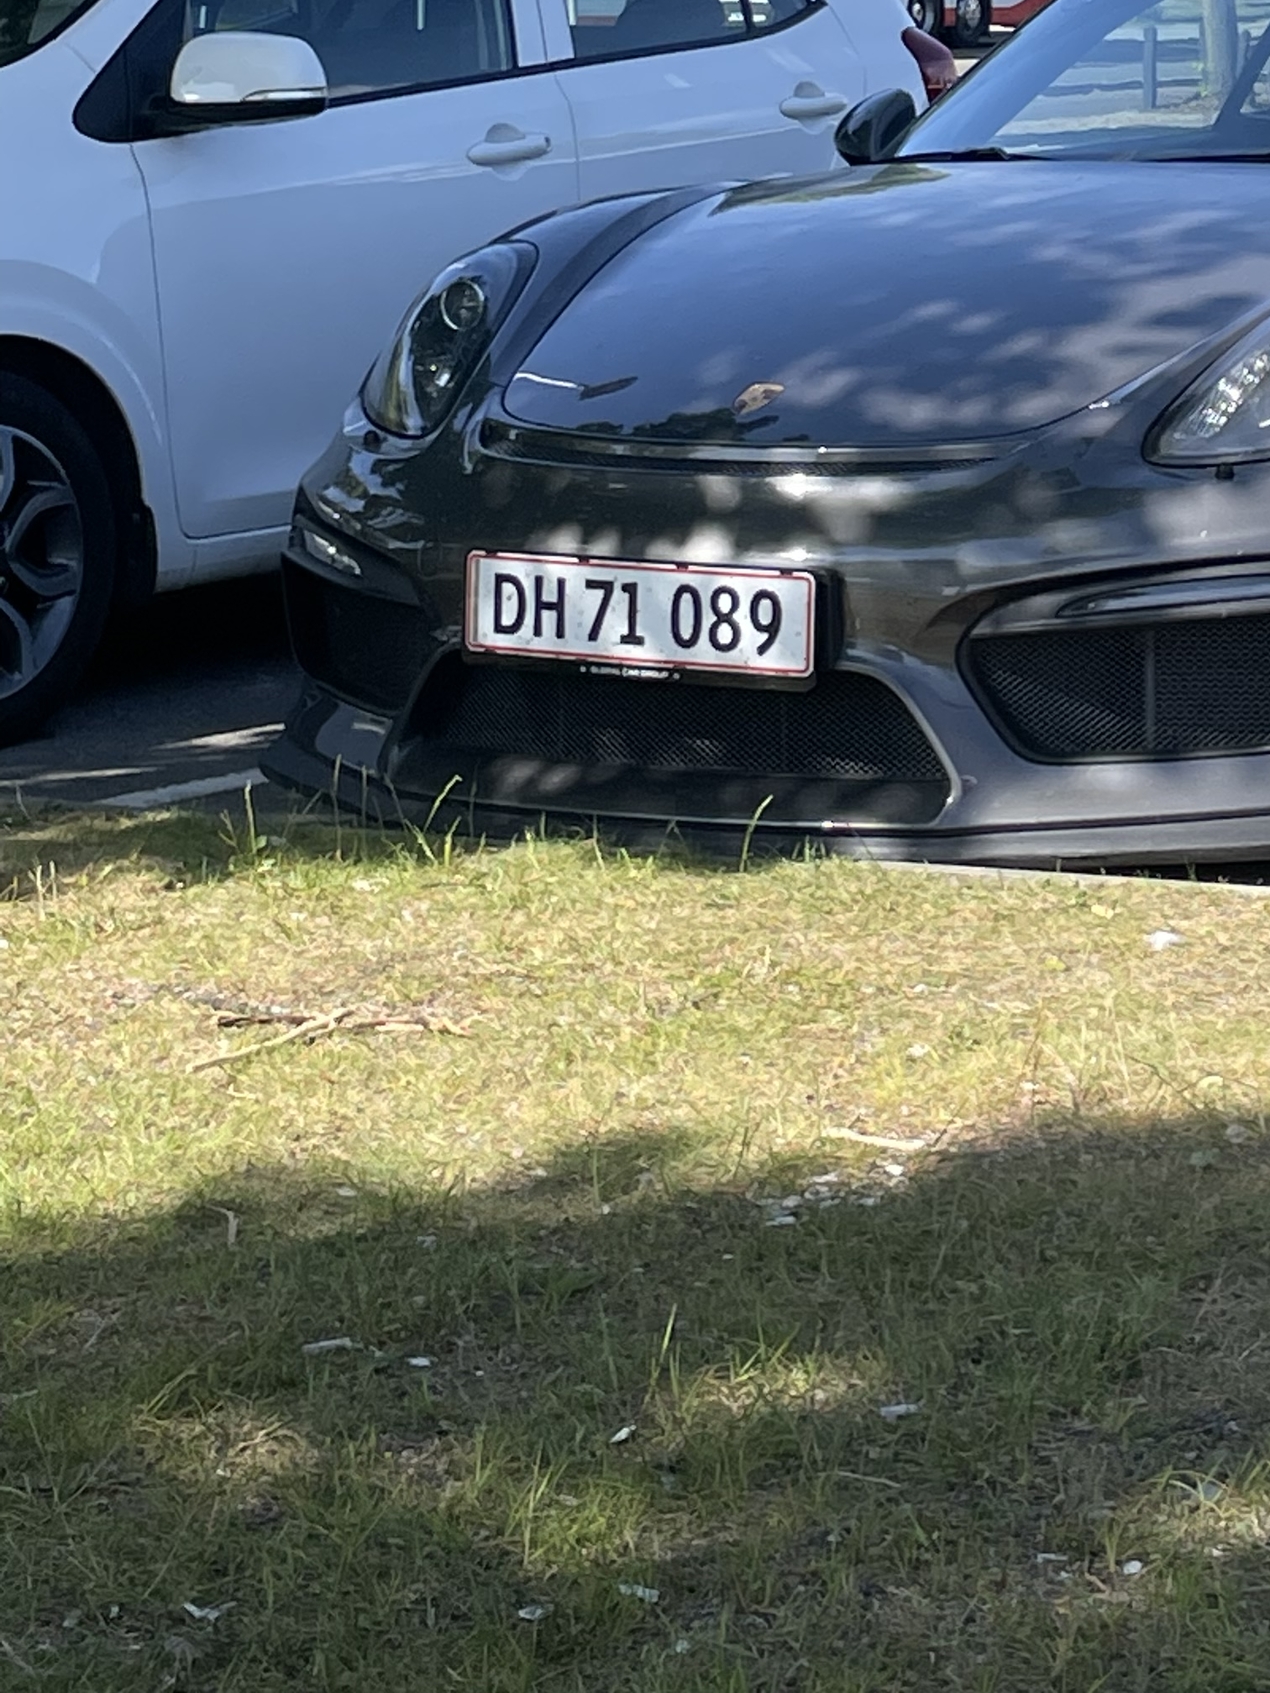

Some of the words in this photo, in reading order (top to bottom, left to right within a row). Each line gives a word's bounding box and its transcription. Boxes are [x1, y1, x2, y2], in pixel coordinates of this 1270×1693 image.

[493, 572, 567, 639] DH
[585, 579, 645, 647] 71
[670, 583, 783, 657] 089
